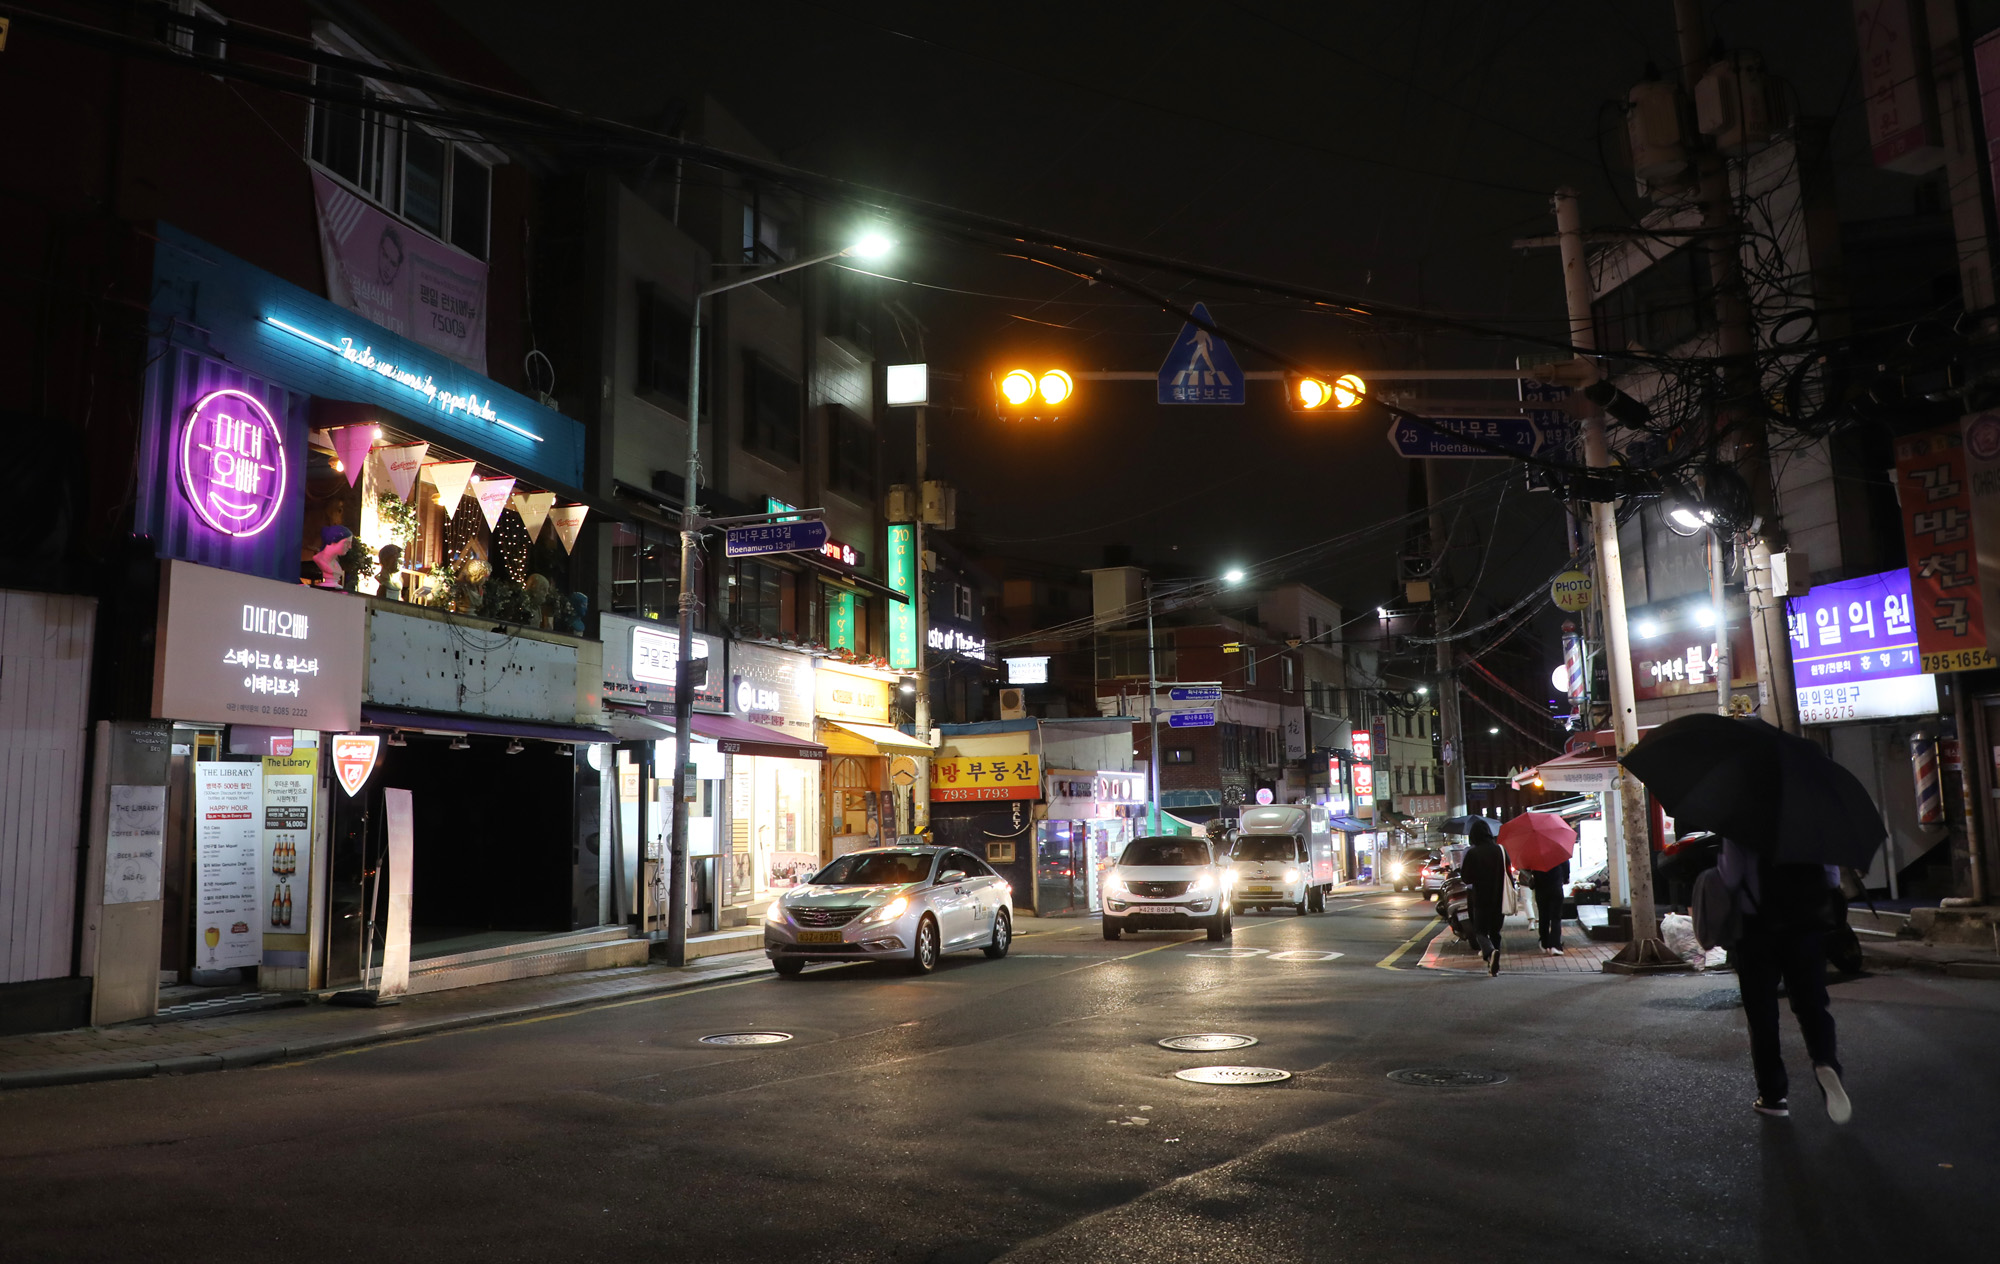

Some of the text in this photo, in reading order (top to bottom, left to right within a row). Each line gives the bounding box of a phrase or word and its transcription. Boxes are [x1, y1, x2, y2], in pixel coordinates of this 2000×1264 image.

[420, 284, 438, 307] 평일
[441, 292, 476, 319] 런치메뉴
[431, 311, 466, 338] 7500원
[341, 337, 375, 370] Taste
[1173, 387, 1231, 401] 횡단보도
[215, 413, 262, 460] 미대
[1401, 430, 1418, 443] 25
[1516, 431, 1530, 445] 21
[211, 451, 261, 495] 오빠
[729, 526, 792, 543] 회나무로13길
[729, 540, 796, 553] Hoenamu-ro 13-gil
[1907, 463, 1975, 637] 김밥천국
[1556, 579, 1592, 592] PHOTO
[1560, 593, 1589, 605] 사진
[242, 604, 309, 640] 미대오빠
[945, 630, 954, 649] of
[223, 648, 319, 676] 스테이크 & 파스타
[1922, 650, 1992, 672] 795-1654
[1651, 657, 1684, 683] 이태원
[244, 674, 300, 698] 이태리포차
[261, 705, 270, 714] 02
[273, 706, 289, 715] 6085
[292, 707, 308, 717] 2222
[1798, 705, 1855, 722] 96-8275
[1288, 745, 1302, 753] Ken
[267, 758, 310, 769] The Library
[966, 761, 1033, 782] 부동산
[202, 768, 255, 777] THE LIBRARY
[241, 782, 253, 790] 할인
[942, 788, 1009, 800] 793-1793
[131, 804, 159, 812] LIBRARY
[1012, 802, 1021, 830] REALTY
